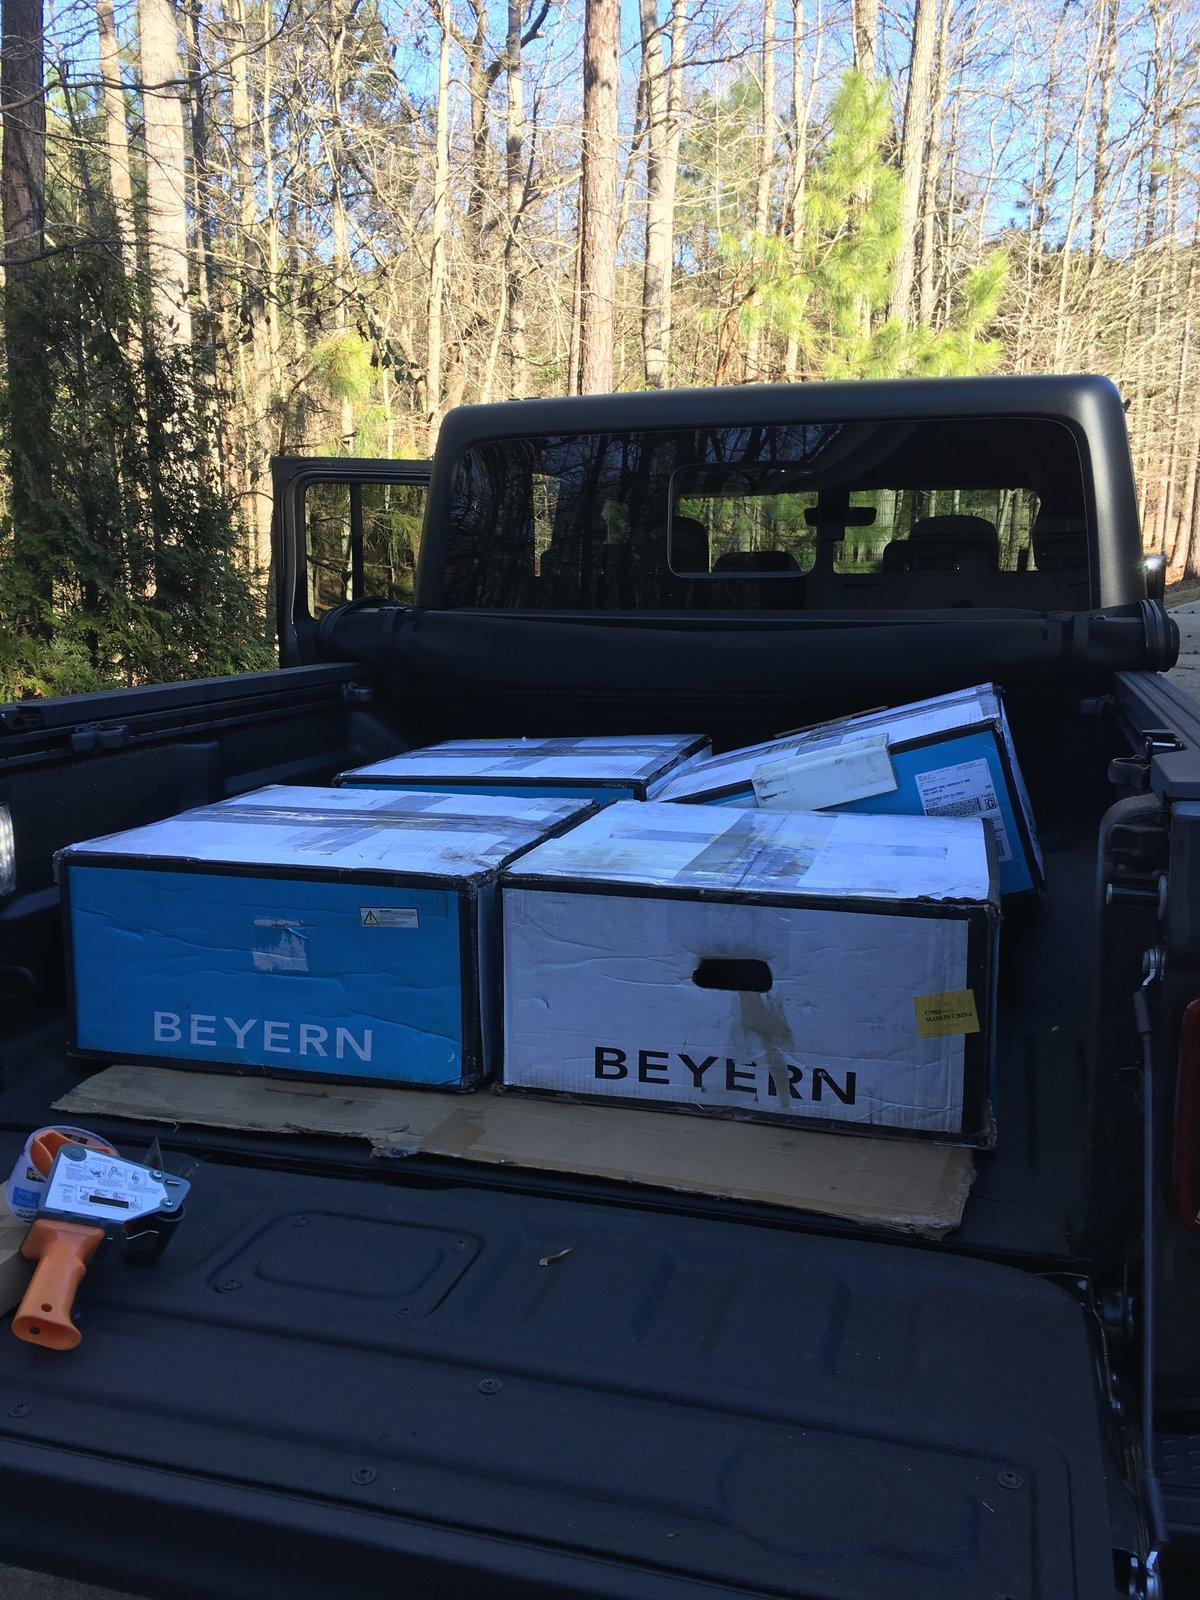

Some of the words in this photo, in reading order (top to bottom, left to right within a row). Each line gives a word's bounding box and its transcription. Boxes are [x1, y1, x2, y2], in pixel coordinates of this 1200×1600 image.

[152, 1010, 373, 1062] BEYERN
[951, 1011, 973, 1020] CHINA
[594, 1046, 856, 1105] BEYERN
